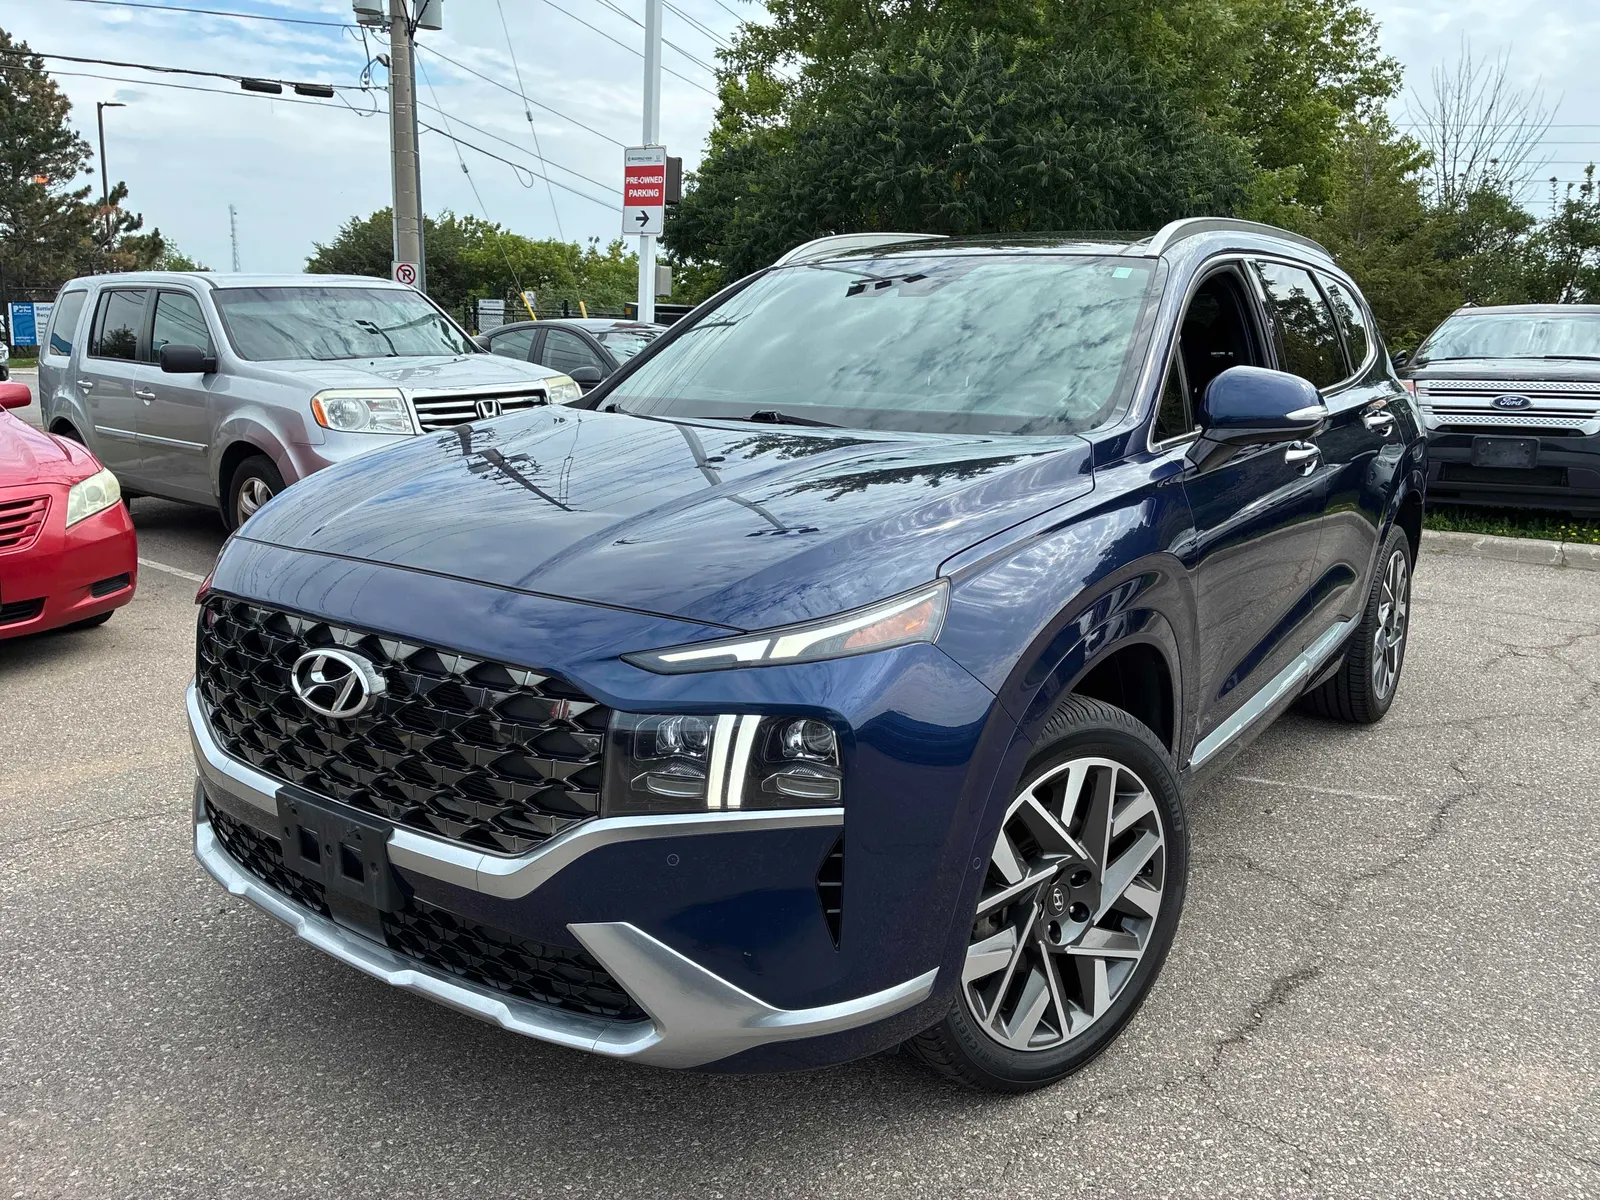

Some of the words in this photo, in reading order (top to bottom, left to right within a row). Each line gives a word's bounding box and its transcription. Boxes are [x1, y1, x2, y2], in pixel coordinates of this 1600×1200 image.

[626, 176, 663, 184] PRE-OWNED
[628, 189, 659, 197] PARKING
[1499, 397, 1524, 406] Ford
[1150, 761, 1182, 827] MICHELIN
